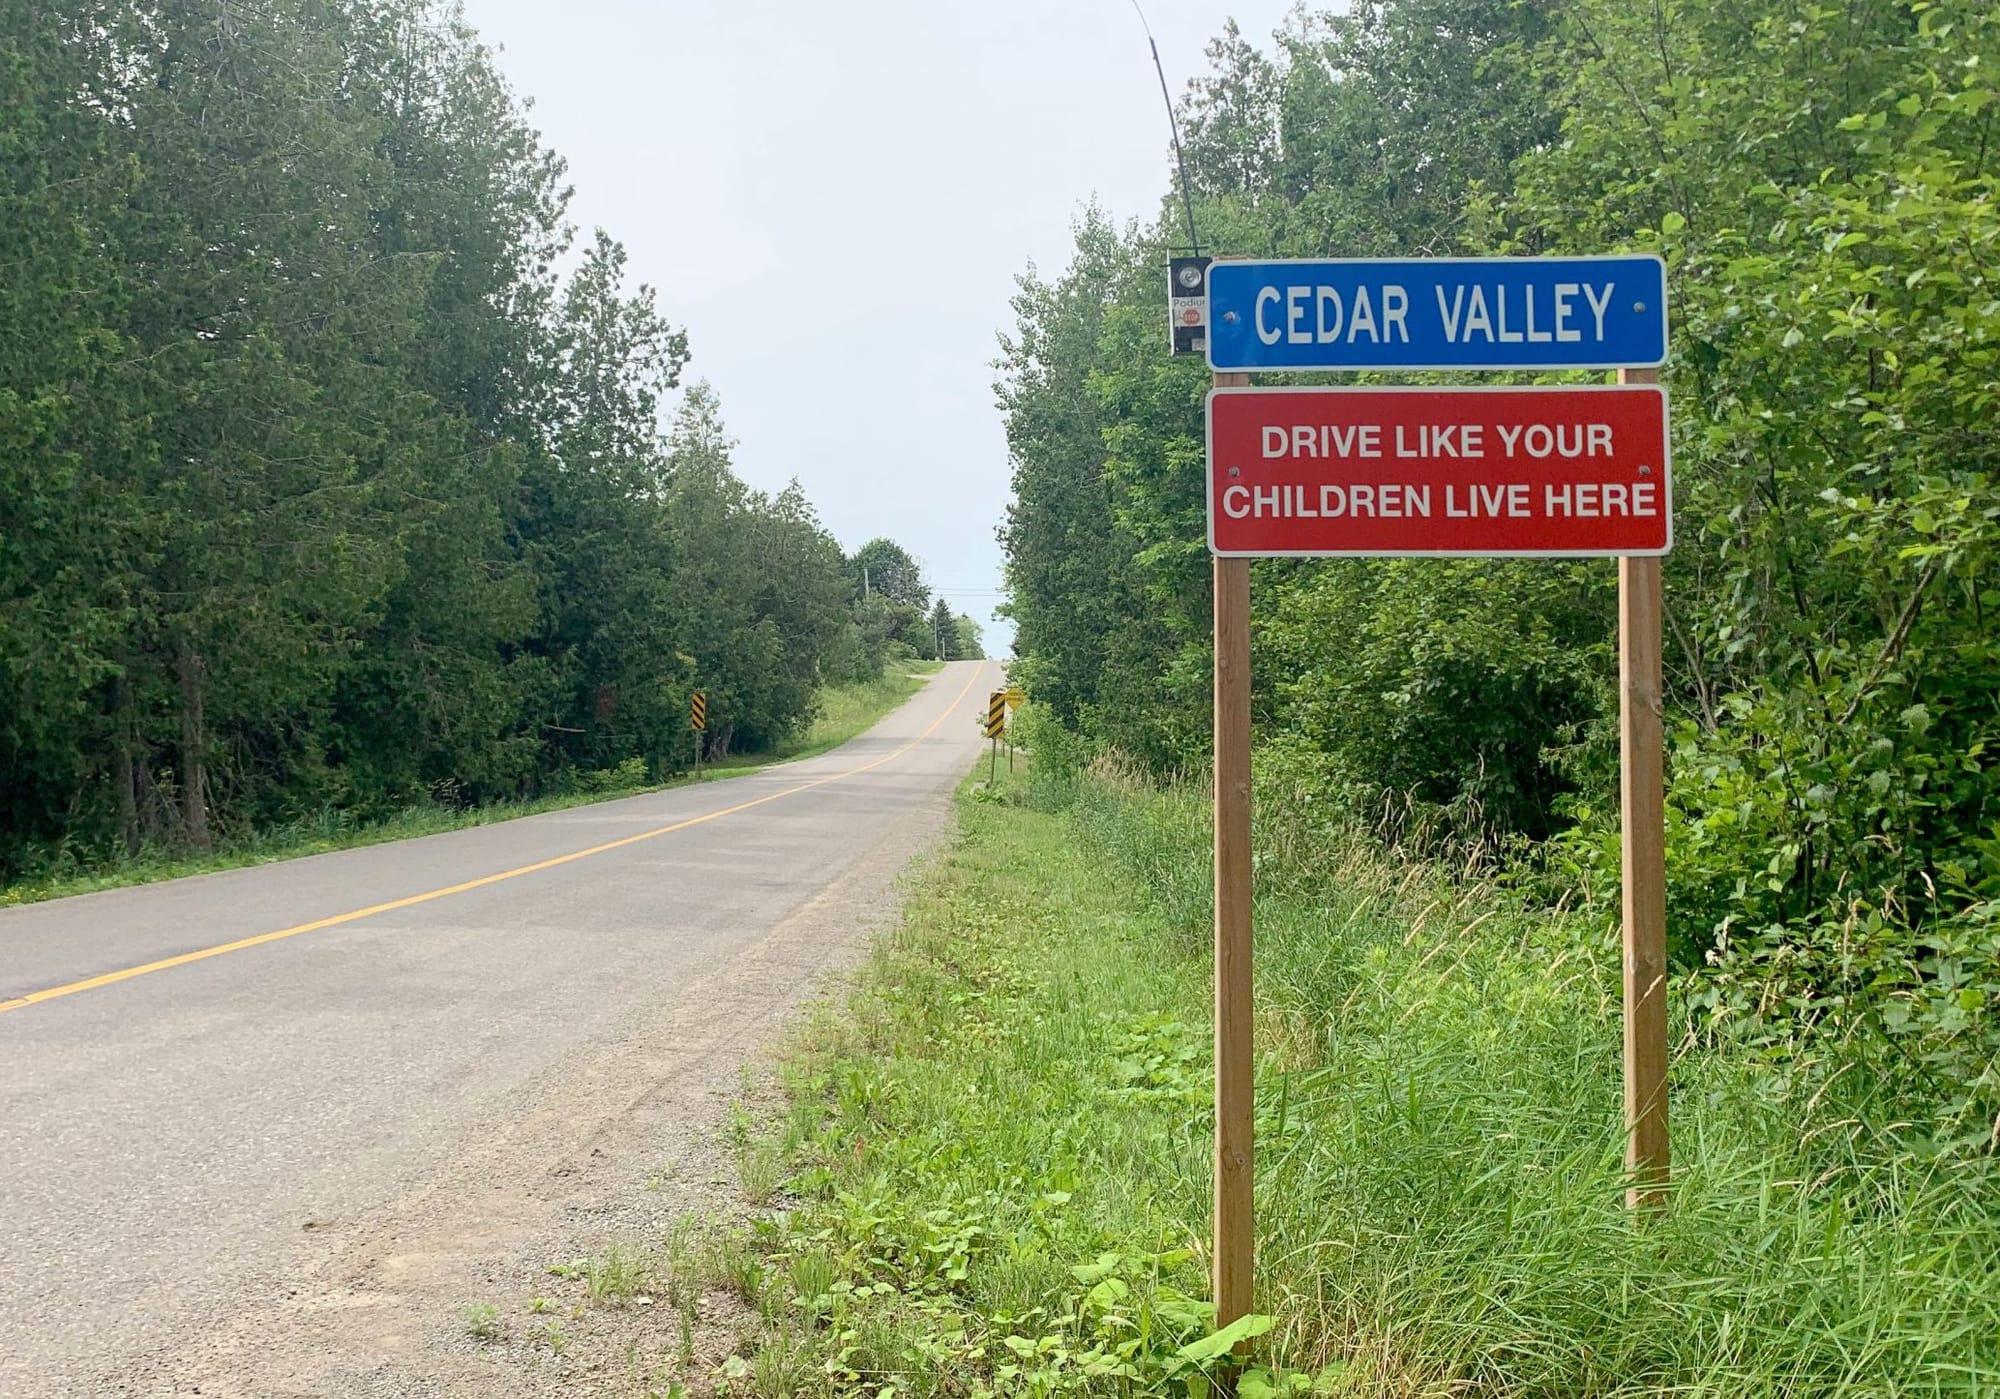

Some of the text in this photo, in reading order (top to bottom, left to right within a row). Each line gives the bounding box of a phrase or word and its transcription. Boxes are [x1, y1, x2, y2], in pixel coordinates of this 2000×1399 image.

[1255, 283, 1614, 345] CEDAR VALLEY
[1262, 424, 1613, 458] DRIVE LIKE YOUR
[1222, 483, 1657, 519] CHILDREN LIVE HERE
